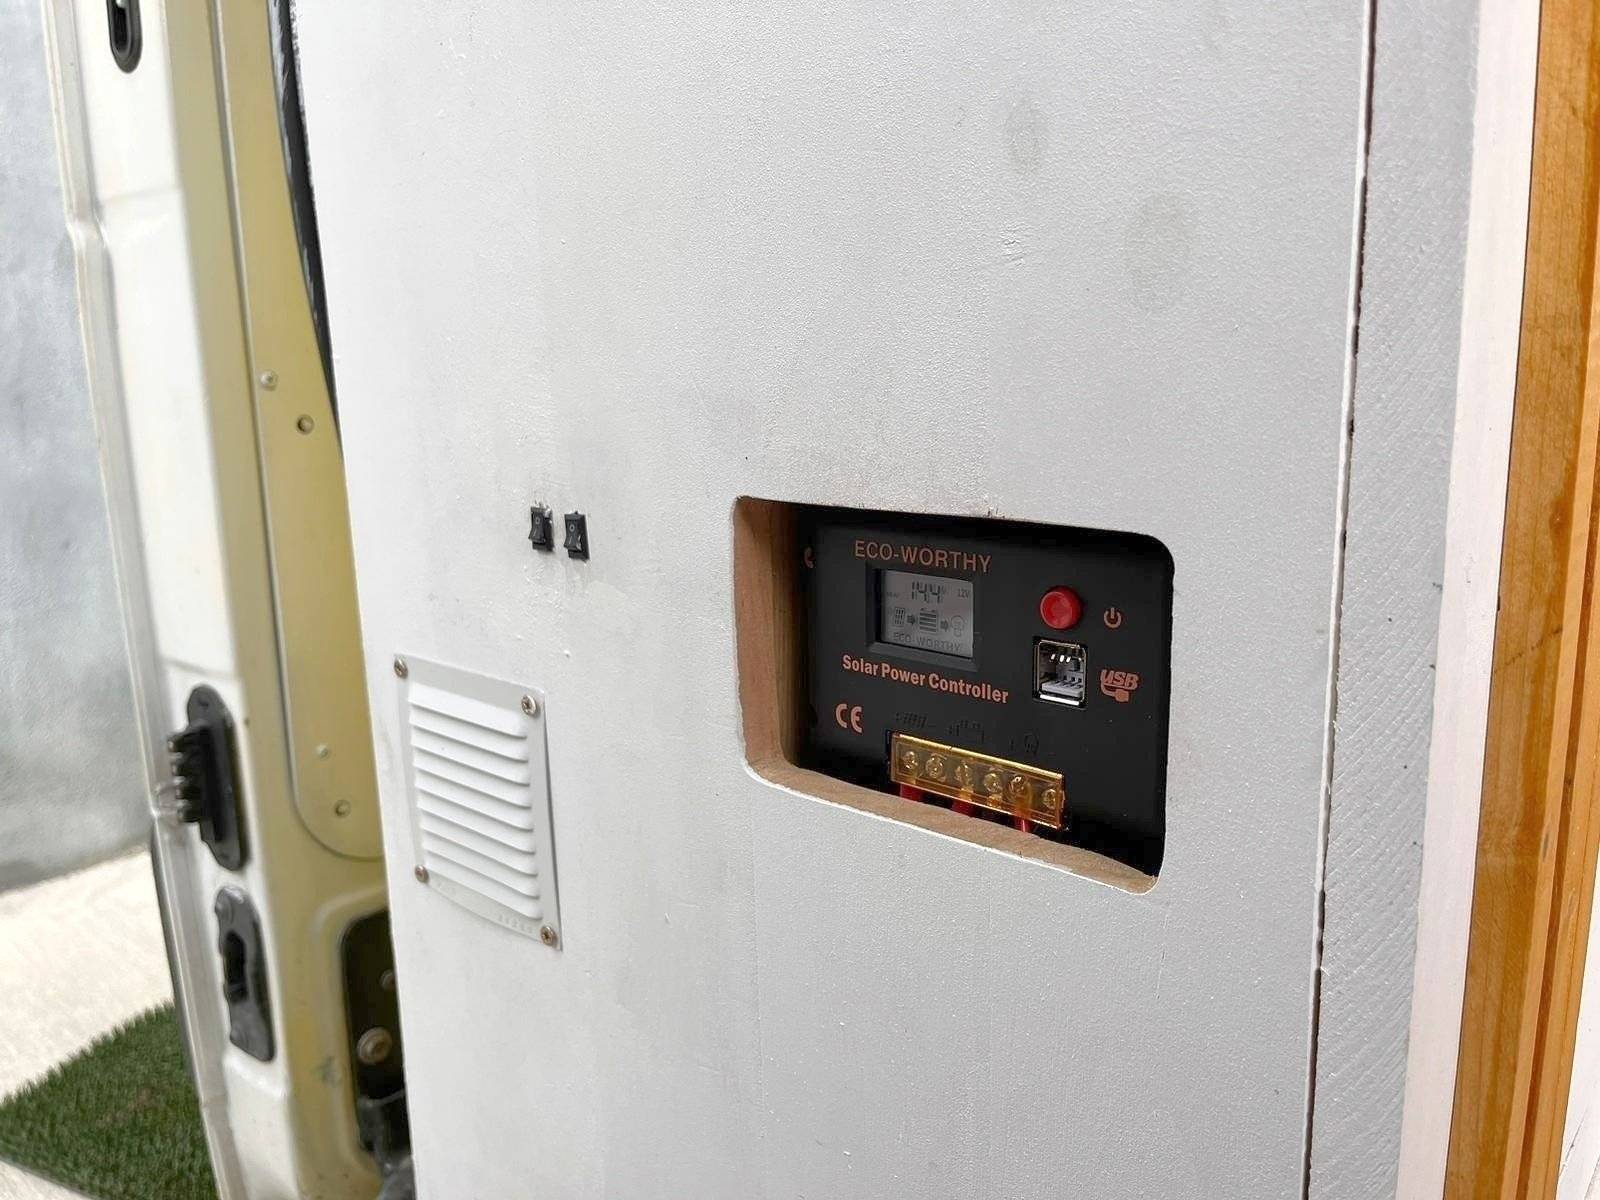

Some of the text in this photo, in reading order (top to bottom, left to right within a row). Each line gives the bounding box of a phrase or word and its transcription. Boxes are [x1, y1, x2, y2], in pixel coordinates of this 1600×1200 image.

[854, 539, 992, 573] ECO-WORTHY
[842, 654, 1009, 704] Solar Power Controller
[1100, 668, 1139, 691] USB
[835, 703, 863, 734] CE
